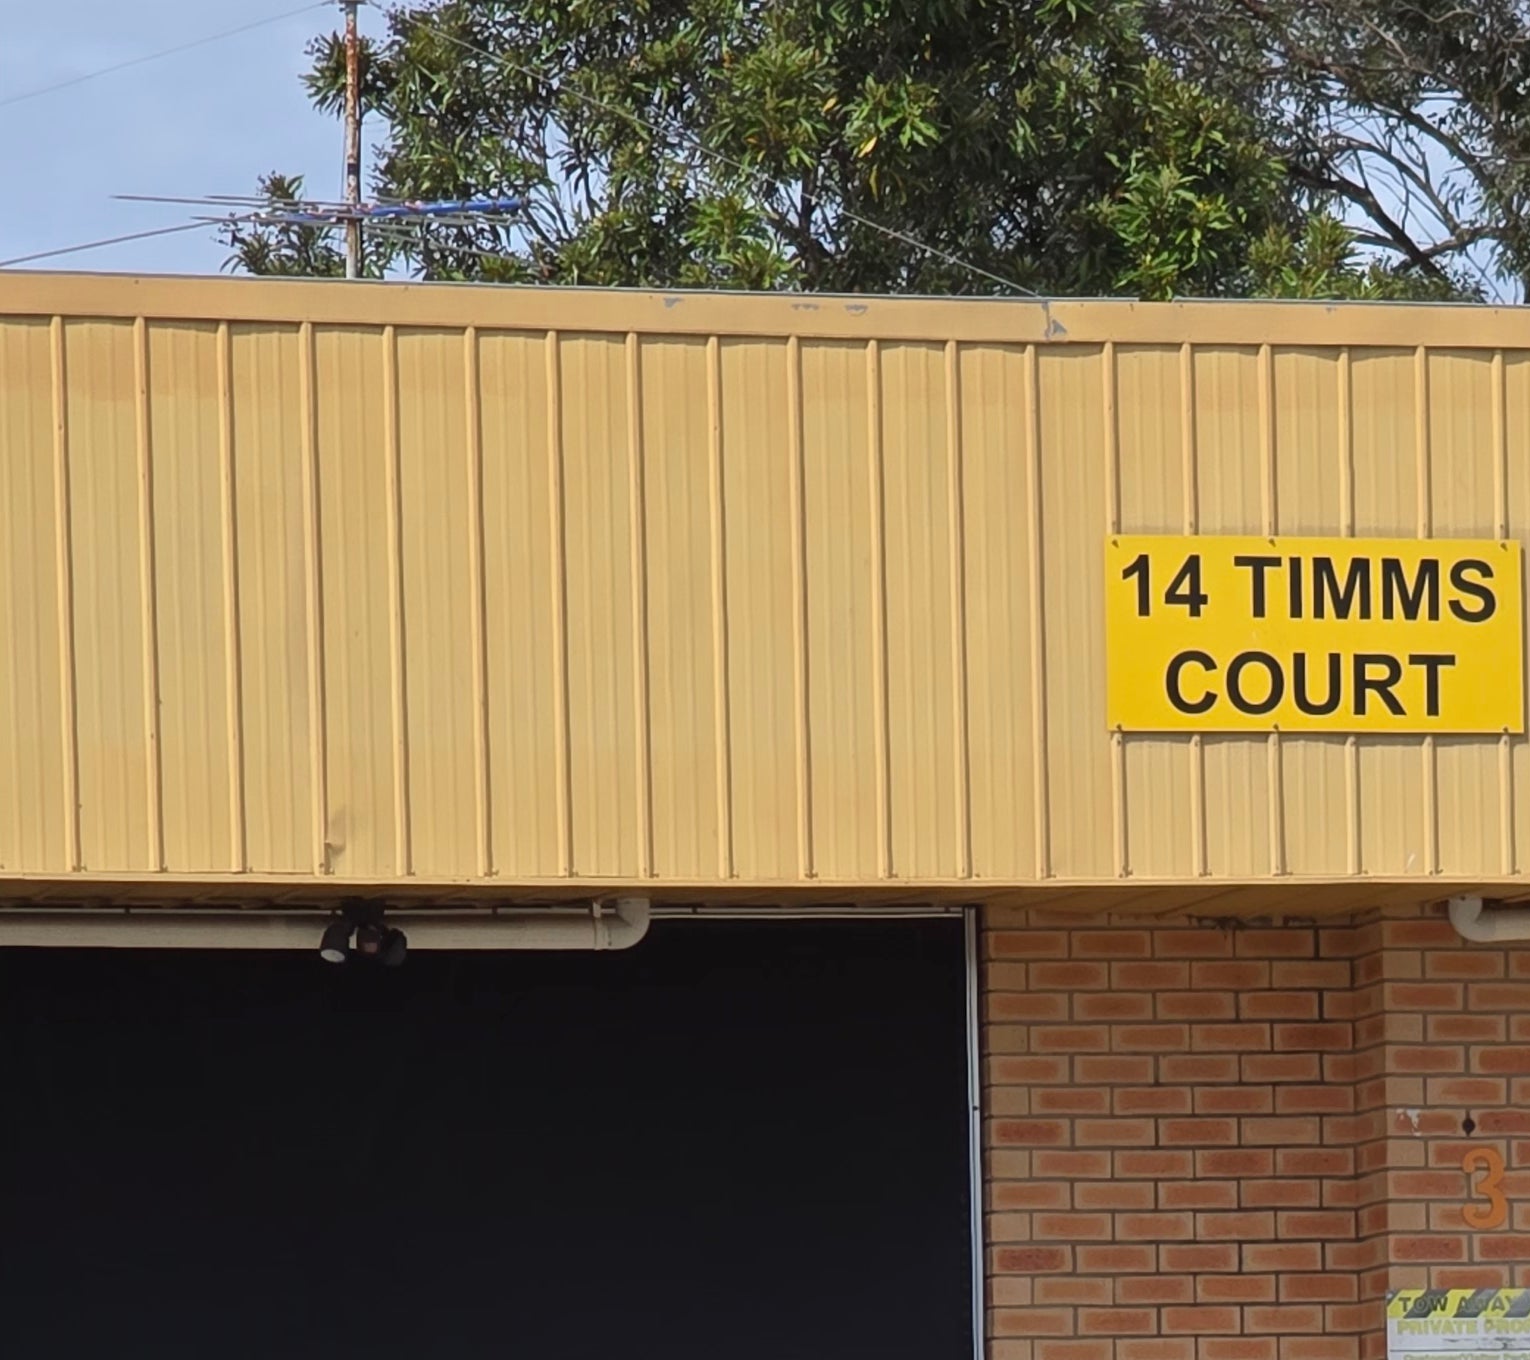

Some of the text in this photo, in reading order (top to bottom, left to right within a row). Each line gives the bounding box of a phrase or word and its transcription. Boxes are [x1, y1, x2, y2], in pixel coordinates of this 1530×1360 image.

[1121, 554, 1497, 622] 14 TIMMS
[1165, 651, 1456, 717] COURT
[1462, 1148, 1508, 1228] 3
[1396, 1319, 1478, 1336] PRIVATE
[1398, 1296, 1449, 1313] TOW
